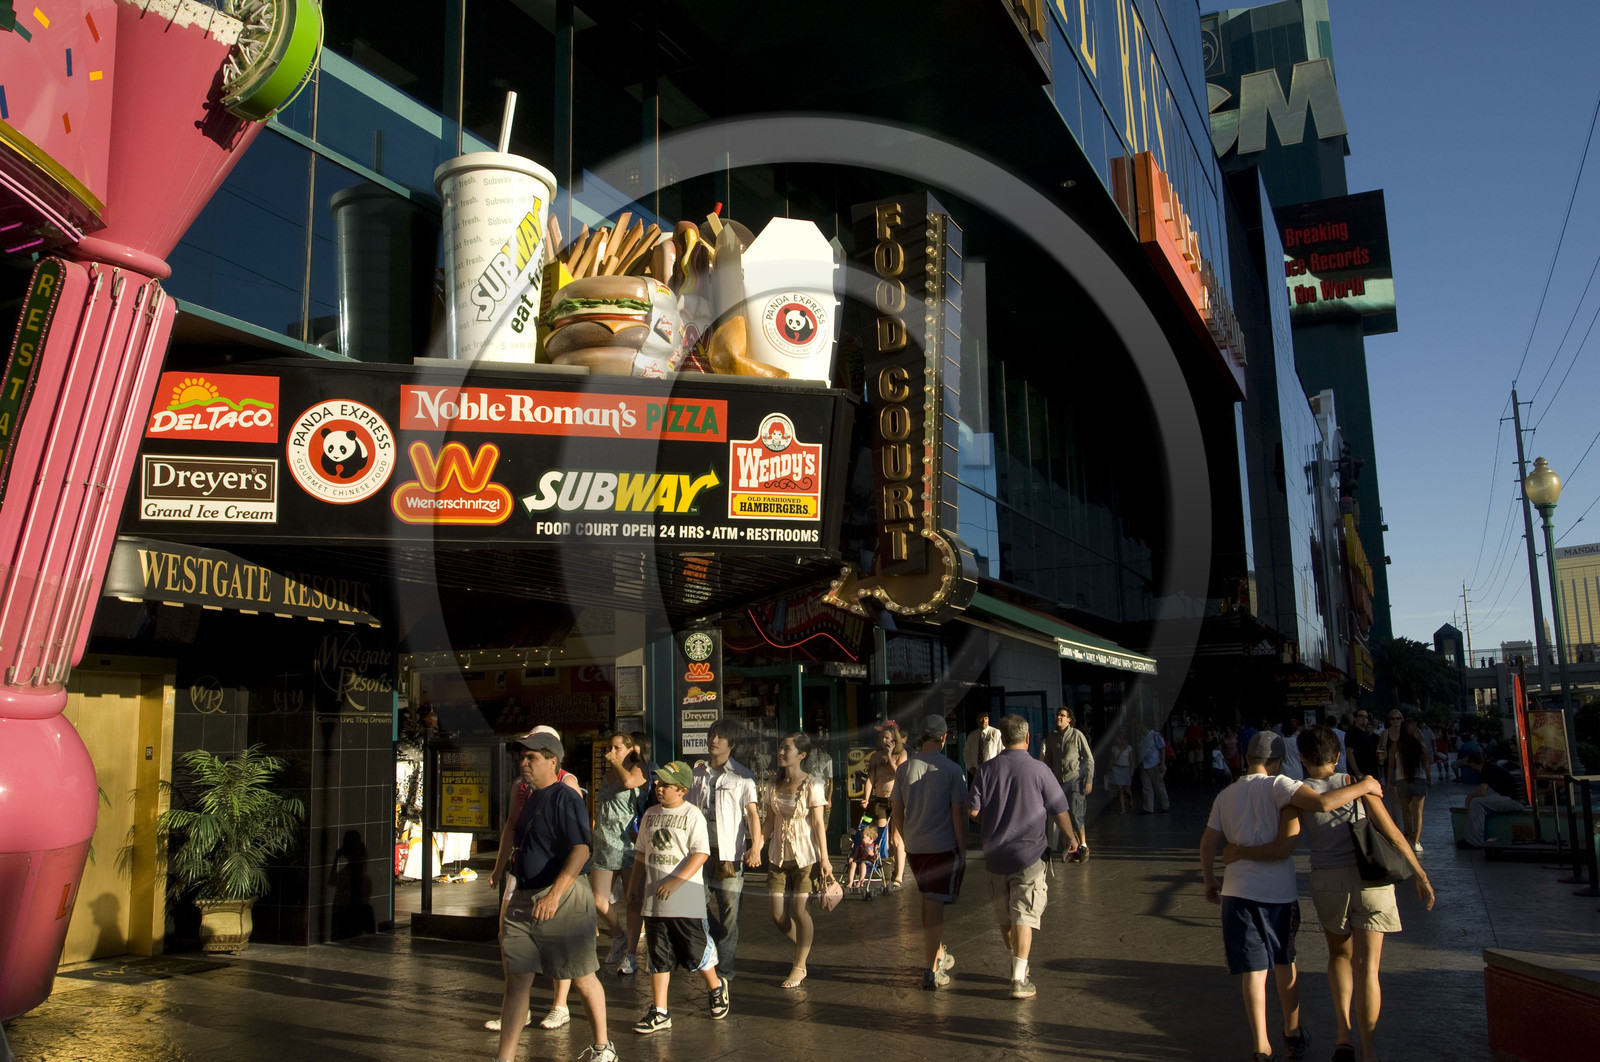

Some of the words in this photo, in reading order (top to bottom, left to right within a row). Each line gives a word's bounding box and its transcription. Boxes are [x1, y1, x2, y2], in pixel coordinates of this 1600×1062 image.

[1285, 222, 1348, 247] Breaking
[470, 195, 542, 321] SUBWAY
[1310, 246, 1370, 272] Records
[874, 203, 907, 352] FOOD
[1294, 284, 1317, 305] the
[1320, 276, 1366, 301] World
[510, 293, 535, 333] eat
[766, 296, 789, 321] PANDA
[794, 294, 825, 324] EXPRESS
[293, 406, 334, 448] PANDA
[340, 404, 391, 450] EXPRESS
[410, 389, 506, 428] Noble
[505, 394, 637, 435] Roman's
[646, 403, 719, 434] PIZZA
[153, 463, 267, 496] Dreyer's
[296, 457, 328, 494] GOURMET
[332, 482, 371, 496] CHINESE
[371, 460, 387, 483] FOOD
[878, 364, 915, 562] COURT
[405, 496, 500, 513] Wienerschnitzel
[522, 469, 720, 514] SUBWAY
[739, 502, 809, 515] HAMBURGERS
[144, 503, 192, 518] Grand
[196, 504, 220, 519] Ice
[224, 505, 274, 520] Cream
[536, 522, 571, 535] FOOD
[575, 522, 618, 537] COURT
[622, 524, 655, 538] OPEN
[659, 525, 676, 538] 24
[747, 528, 819, 542] RESTROOMS
[137, 549, 272, 603] WESTGATE
[282, 570, 373, 615] RESORTS
[322, 632, 391, 673] Westgate
[336, 666, 393, 710] Resorts
[685, 711, 716, 722] Dreyer's
[646, 814, 688, 831] FOOTBALL
